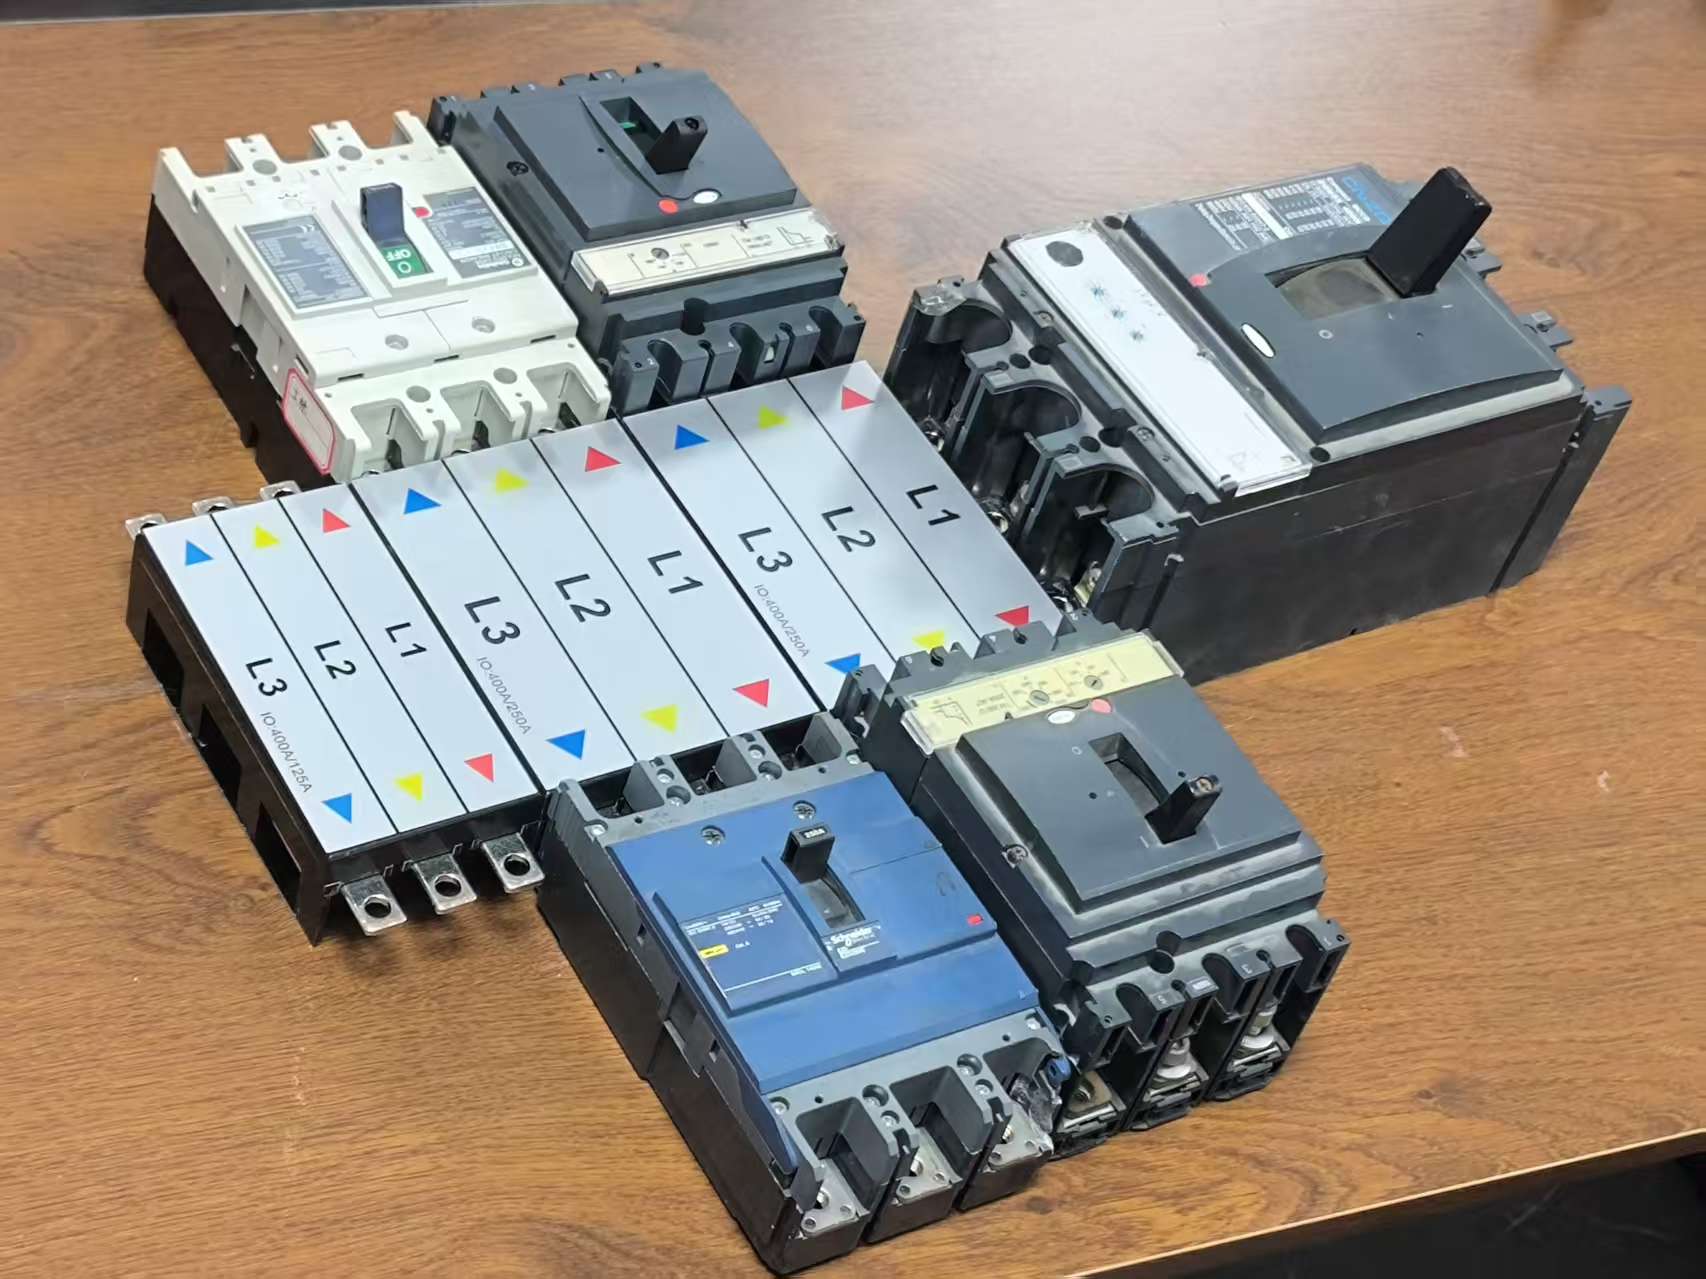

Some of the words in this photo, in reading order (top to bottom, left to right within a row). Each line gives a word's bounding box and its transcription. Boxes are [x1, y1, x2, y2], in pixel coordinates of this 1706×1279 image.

[386, 248, 411, 262] OFF
[905, 484, 961, 526] L1
[737, 526, 793, 573] L3
[821, 505, 876, 553] L2
[647, 550, 704, 595] L1
[554, 573, 612, 623] L2
[384, 621, 428, 658] L1
[463, 595, 521, 645] L3
[245, 657, 288, 697] L3
[313, 639, 357, 680] L2
